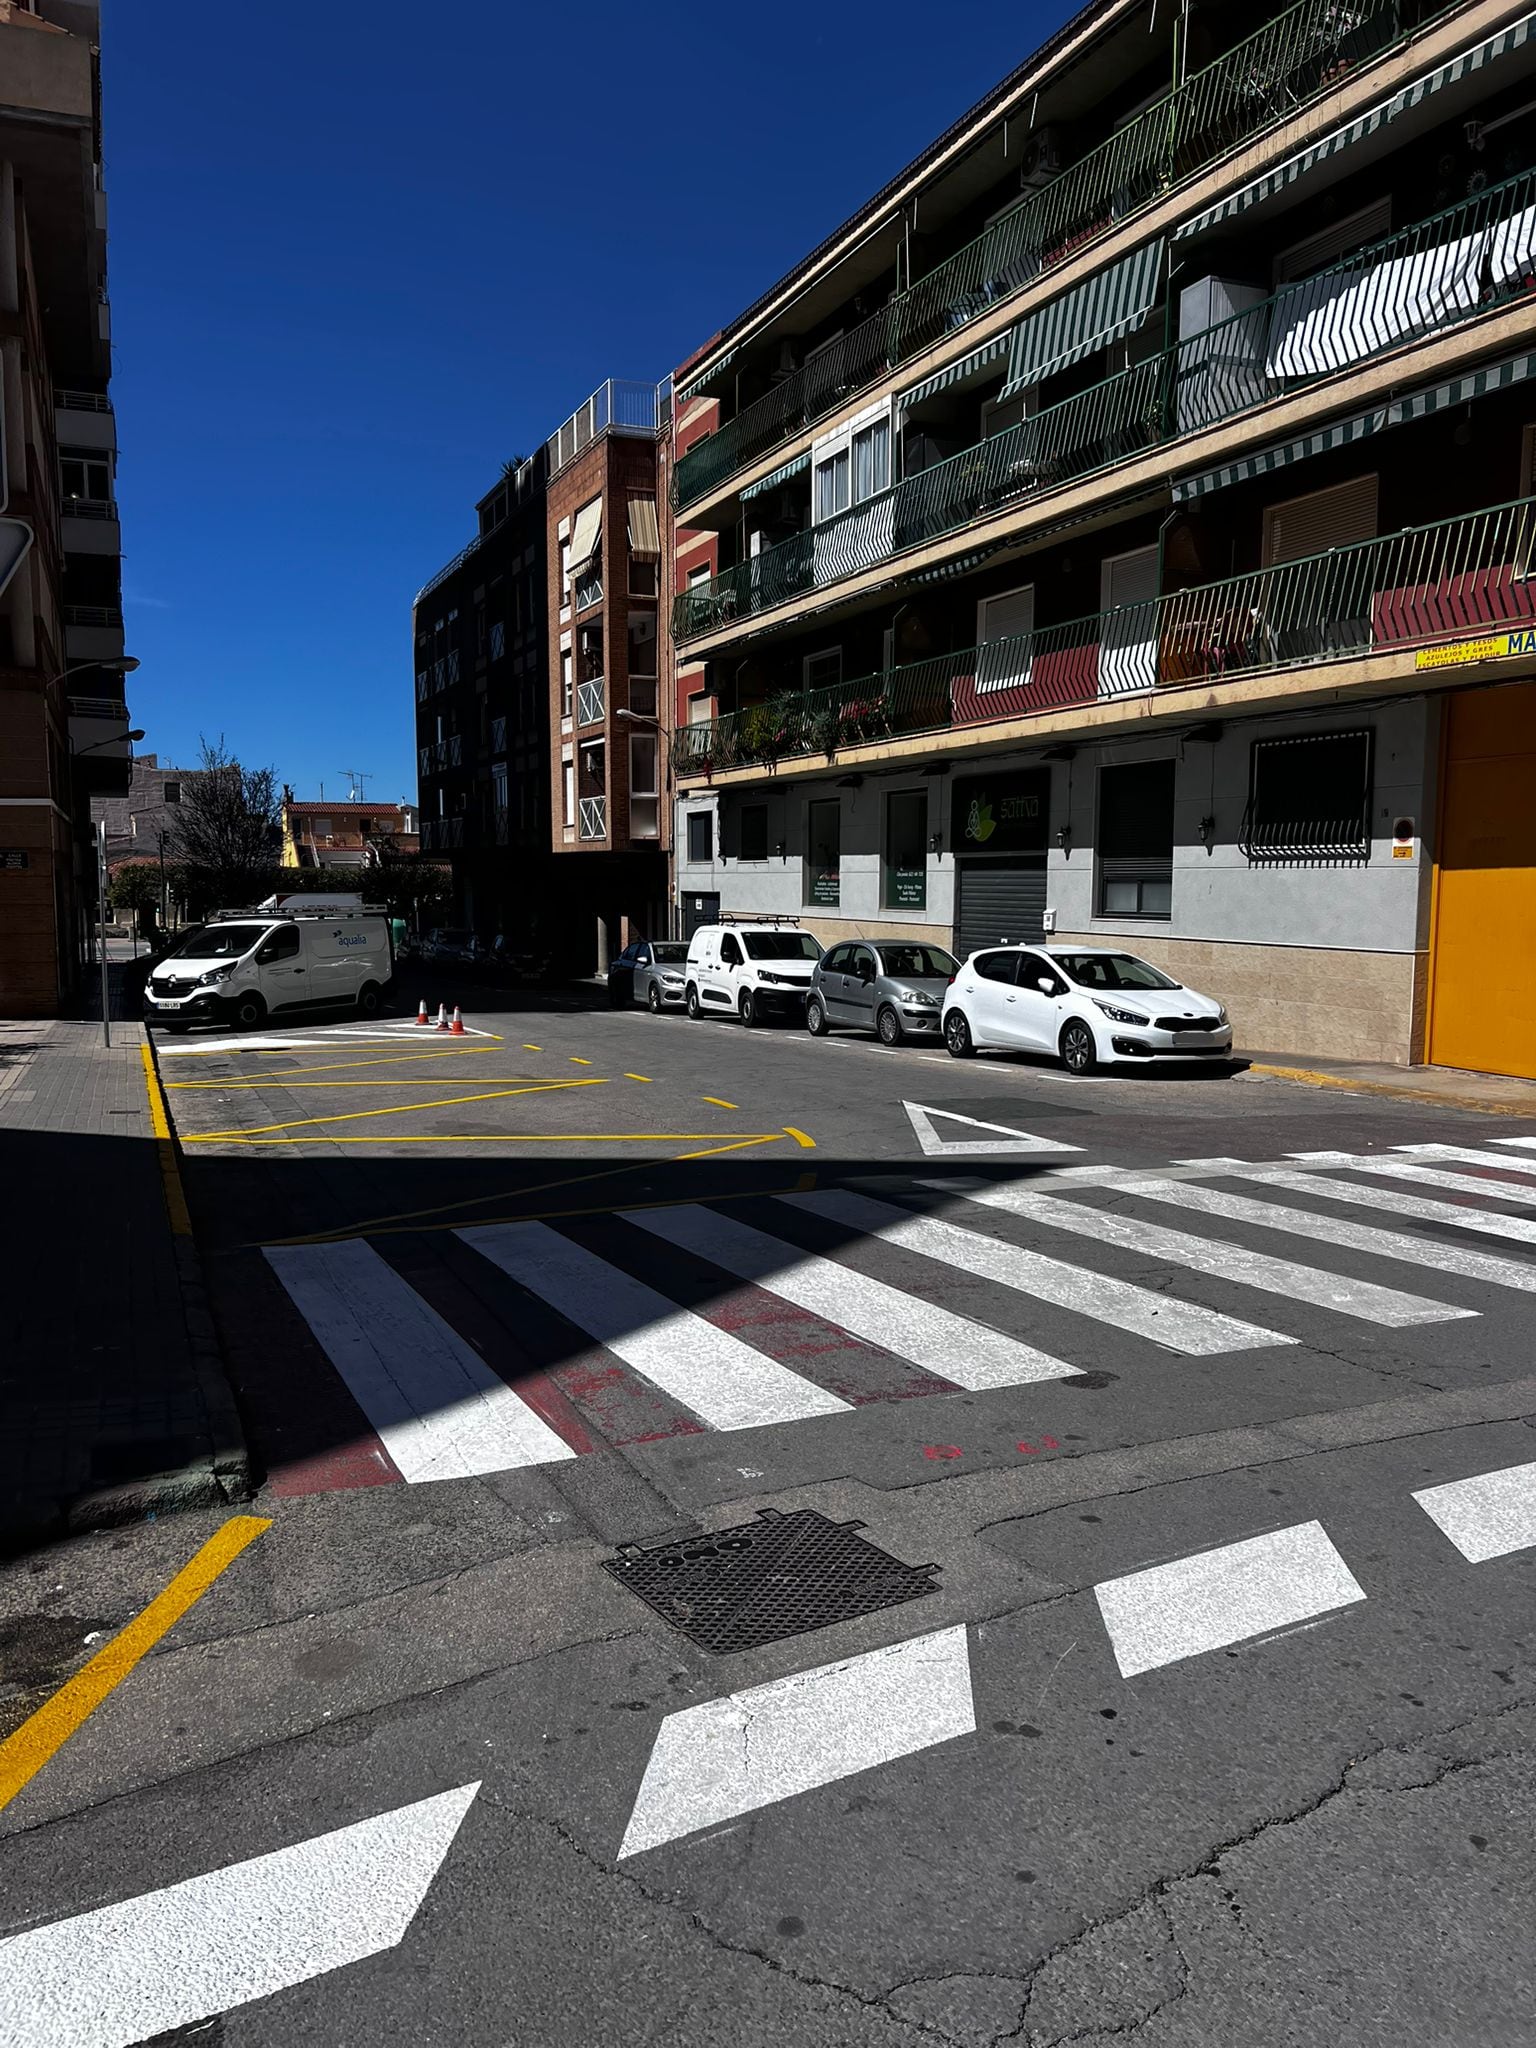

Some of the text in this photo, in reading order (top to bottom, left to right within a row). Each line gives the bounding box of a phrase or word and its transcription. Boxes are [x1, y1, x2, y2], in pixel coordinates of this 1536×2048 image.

[1423, 643, 1462, 654] CEMENTOS
[1425, 651, 1462, 661] AZULEJOS
[1473, 645, 1493, 653] GRES
[1418, 657, 1459, 668] ESCAYOLAS
[1470, 651, 1501, 659] PLADUR
[338, 934, 367, 947] aqualia
